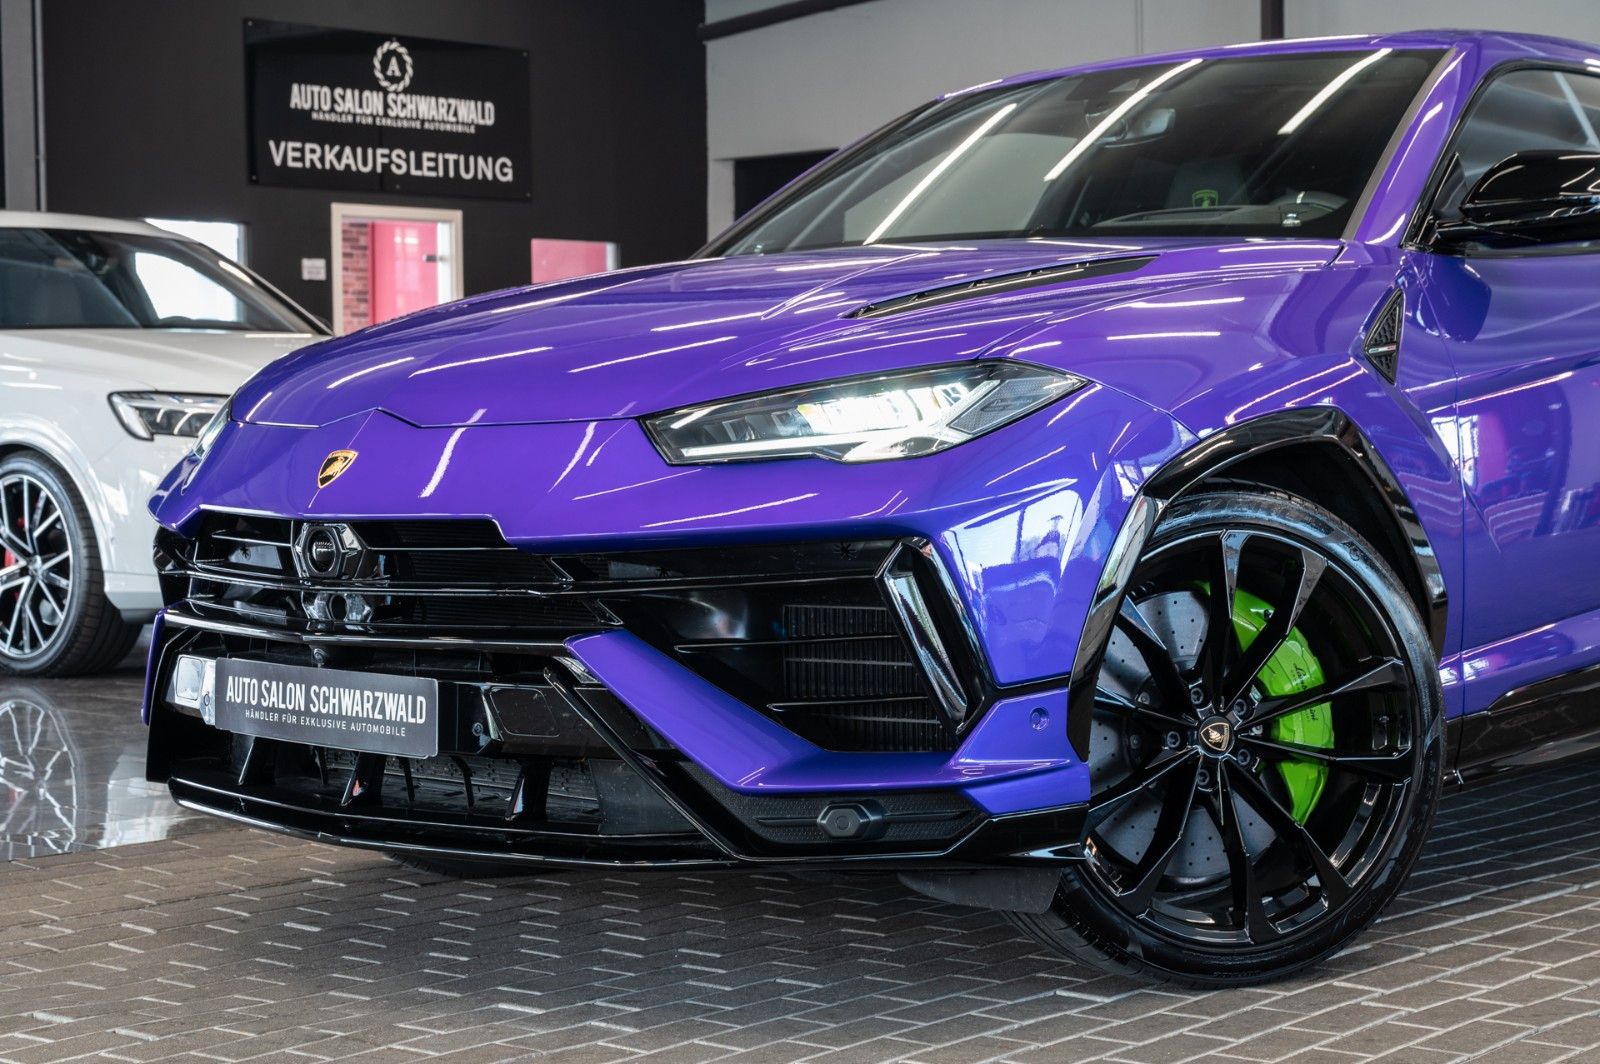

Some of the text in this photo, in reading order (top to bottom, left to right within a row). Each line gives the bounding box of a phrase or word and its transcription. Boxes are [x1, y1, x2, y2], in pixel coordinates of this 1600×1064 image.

[386, 56, 402, 77] A
[290, 82, 496, 127] AUTO SALON SCHWARZWALD
[375, 116, 422, 130] EXKLUSIVE
[423, 120, 476, 134] AUTOMOBILE
[268, 140, 514, 183] VERKAUFSLEITUNG
[226, 675, 427, 725] AUTO SALON SCHWARZWALD
[245, 709, 406, 737] HÄNDLER FÜR EXKLUSIVE AUTOMOBILE
